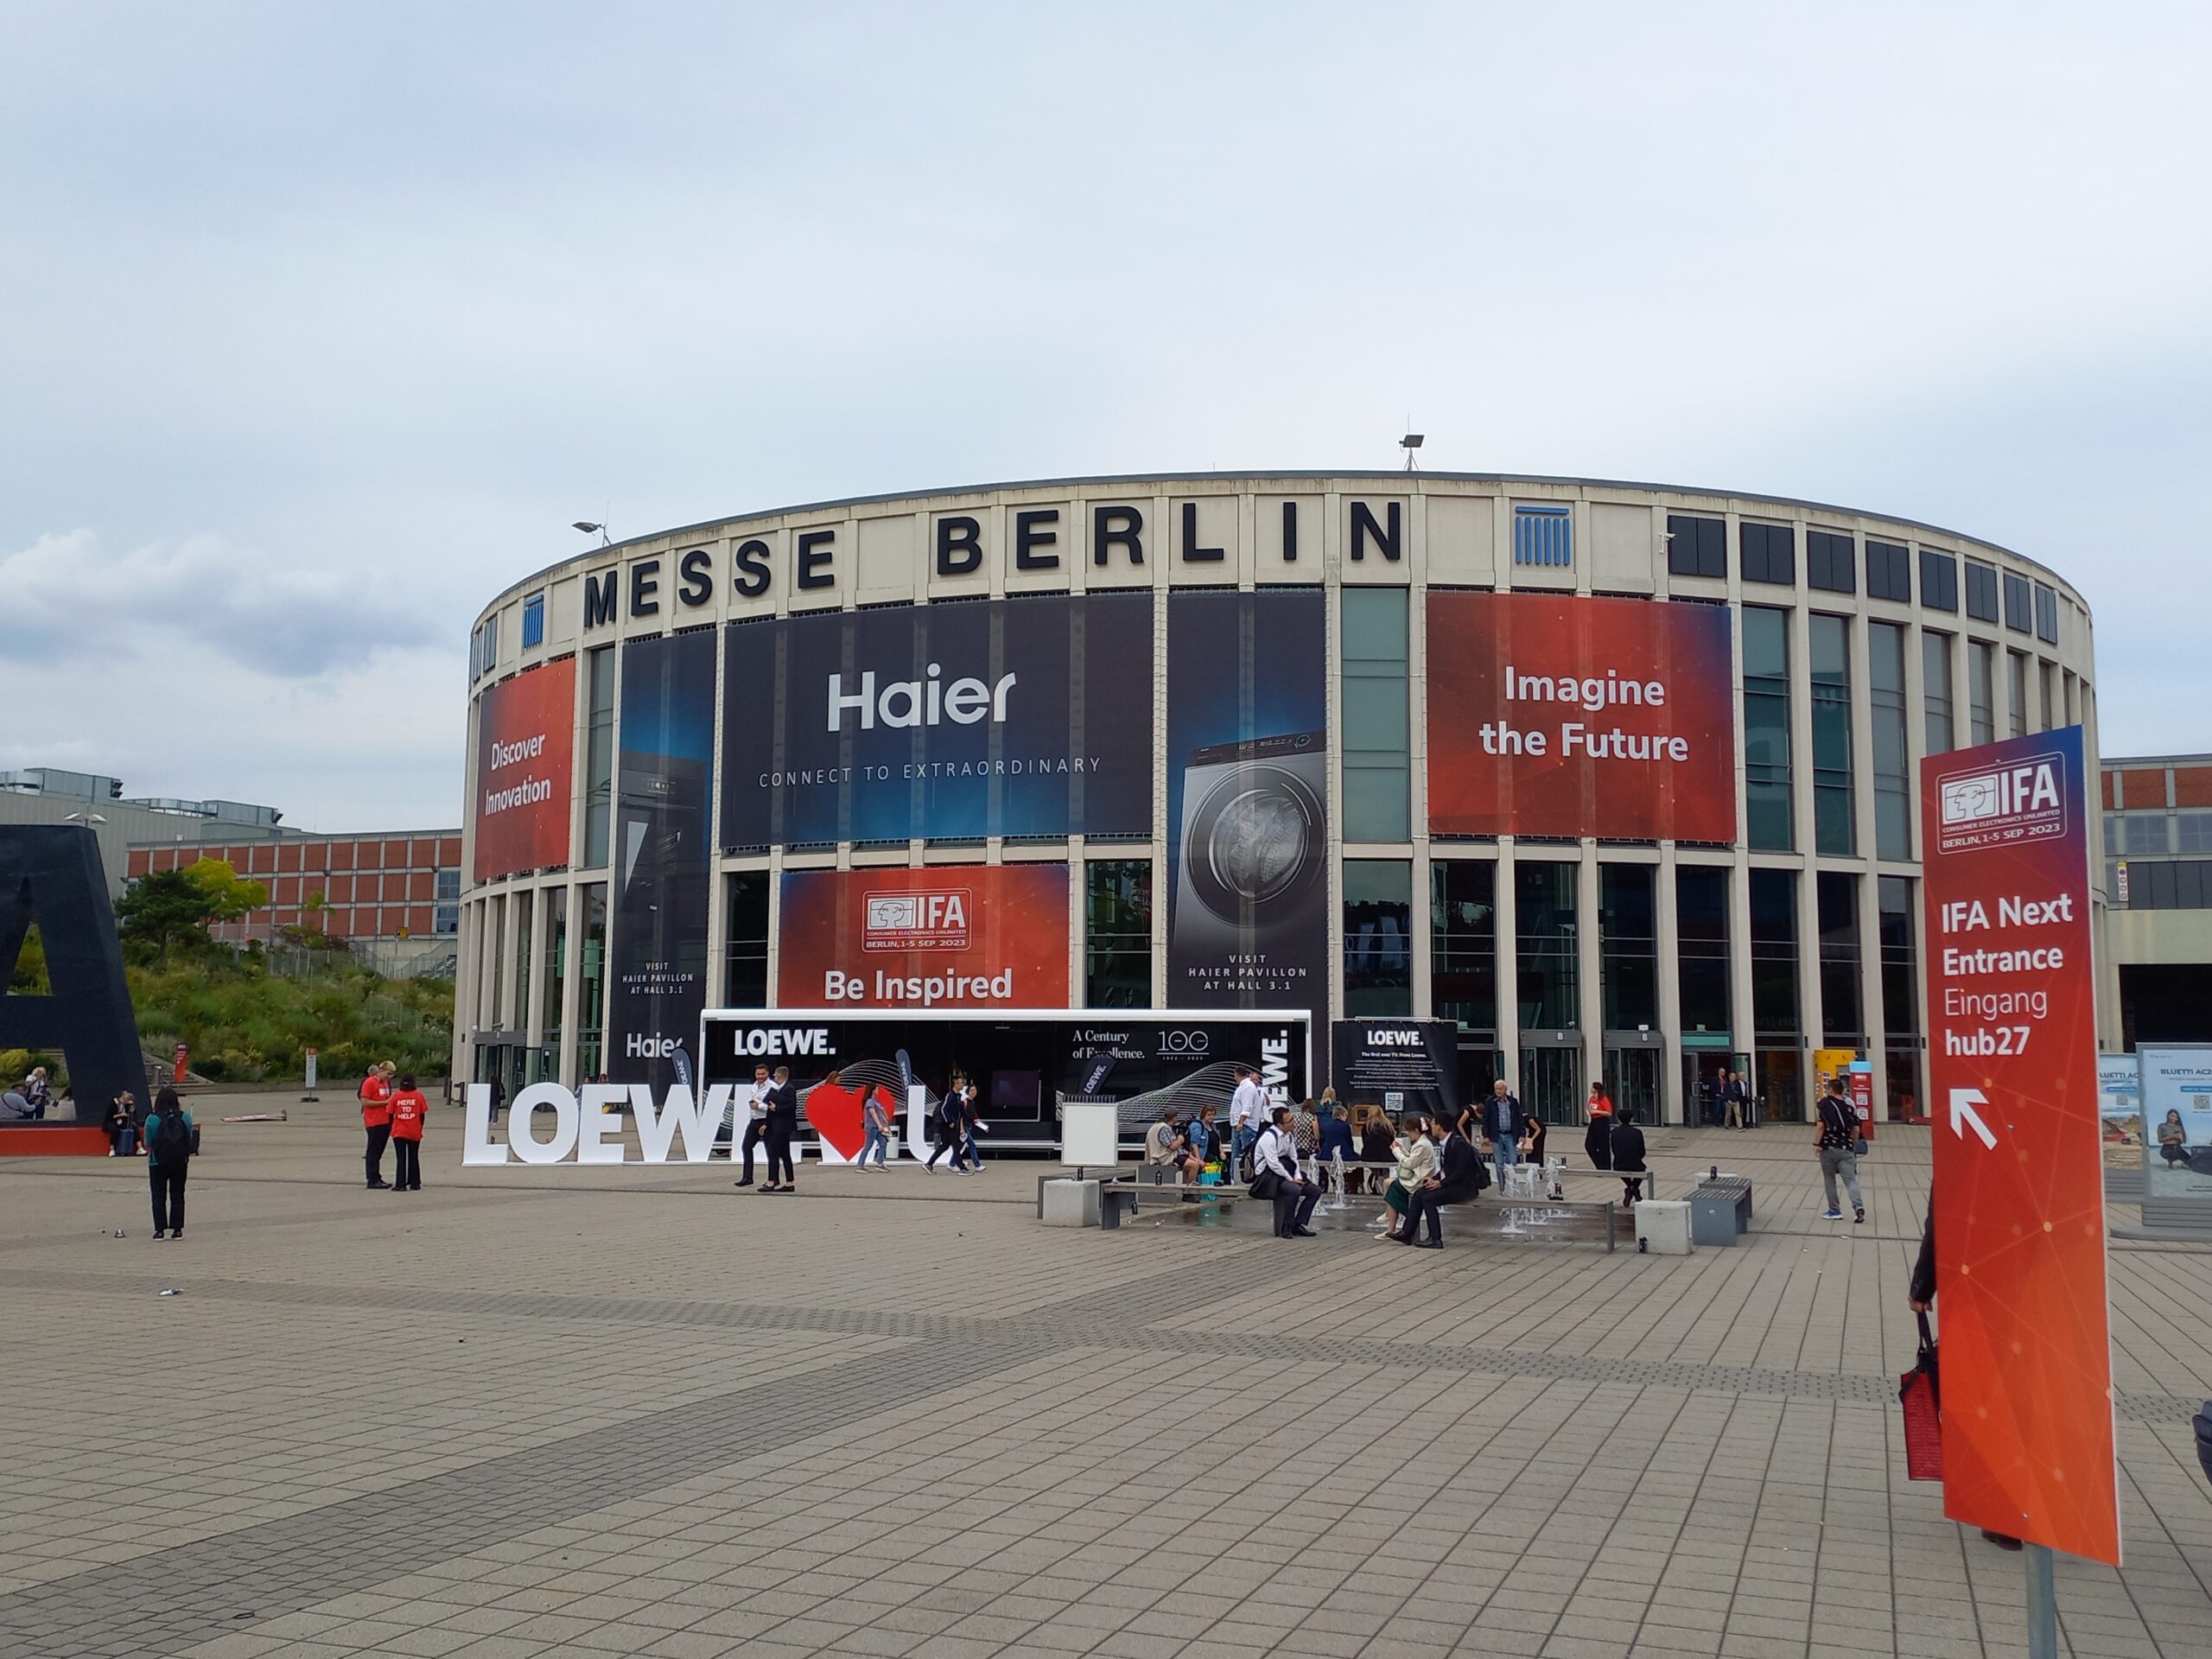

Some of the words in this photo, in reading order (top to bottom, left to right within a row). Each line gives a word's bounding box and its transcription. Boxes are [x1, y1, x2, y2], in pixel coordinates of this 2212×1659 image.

[584, 531, 836, 628] MESSE
[937, 501, 1401, 575] BERLIN
[827, 663, 1017, 732] Haier
[1505, 665, 1665, 711] Imagine
[491, 733, 546, 771] Discover
[1478, 721, 1547, 756] the
[1561, 722, 1688, 761] Future
[759, 767, 851, 788] CONNECT
[864, 766, 889, 781] TO
[903, 757, 1101, 779] EXTRAORDINARY
[485, 774, 551, 816] Innovation
[2000, 764, 2060, 816] IFA
[1942, 822, 1978, 834] CONSUMER
[1979, 816, 2022, 828] ELECTRONICS
[2023, 809, 2061, 820] UNLIMITED
[1942, 836, 1981, 849] BERLIN,
[1982, 832, 1999, 842] 1-5
[2003, 829, 2024, 840] SEP
[2028, 823, 2061, 836] 2023
[918, 895, 966, 929] IFA
[1942, 899, 1991, 933] IFA
[1998, 893, 2073, 928] Next
[645, 962, 669, 971] VISIT
[1188, 968, 1230, 977] HAIER
[1238, 968, 1306, 977] PAVILLON
[1229, 955, 1267, 963] VISIT
[1942, 947, 2063, 976] Entrance
[622, 975, 647, 983] HAIER
[651, 973, 693, 982] PAVILLON
[824, 970, 864, 1001] Be
[875, 968, 1013, 1006] Inspired
[1204, 982, 1220, 990] AT
[1228, 982, 1262, 990] HALL
[1269, 982, 1291, 990] 3.1
[1944, 988, 2048, 1021] Eingang
[734, 1028, 836, 1056] LOEWE.
[1072, 1030, 1083, 1042] A
[1085, 1030, 1129, 1044] Century
[1158, 1031, 1209, 1051] 100
[1367, 1030, 1424, 1046] LOEWE.
[1945, 1026, 2031, 1057] hub27
[1072, 1047, 1084, 1058] of
[1084, 1065, 1106, 1094] LOEWE.
[1262, 1030, 1287, 1123] OEWE.
